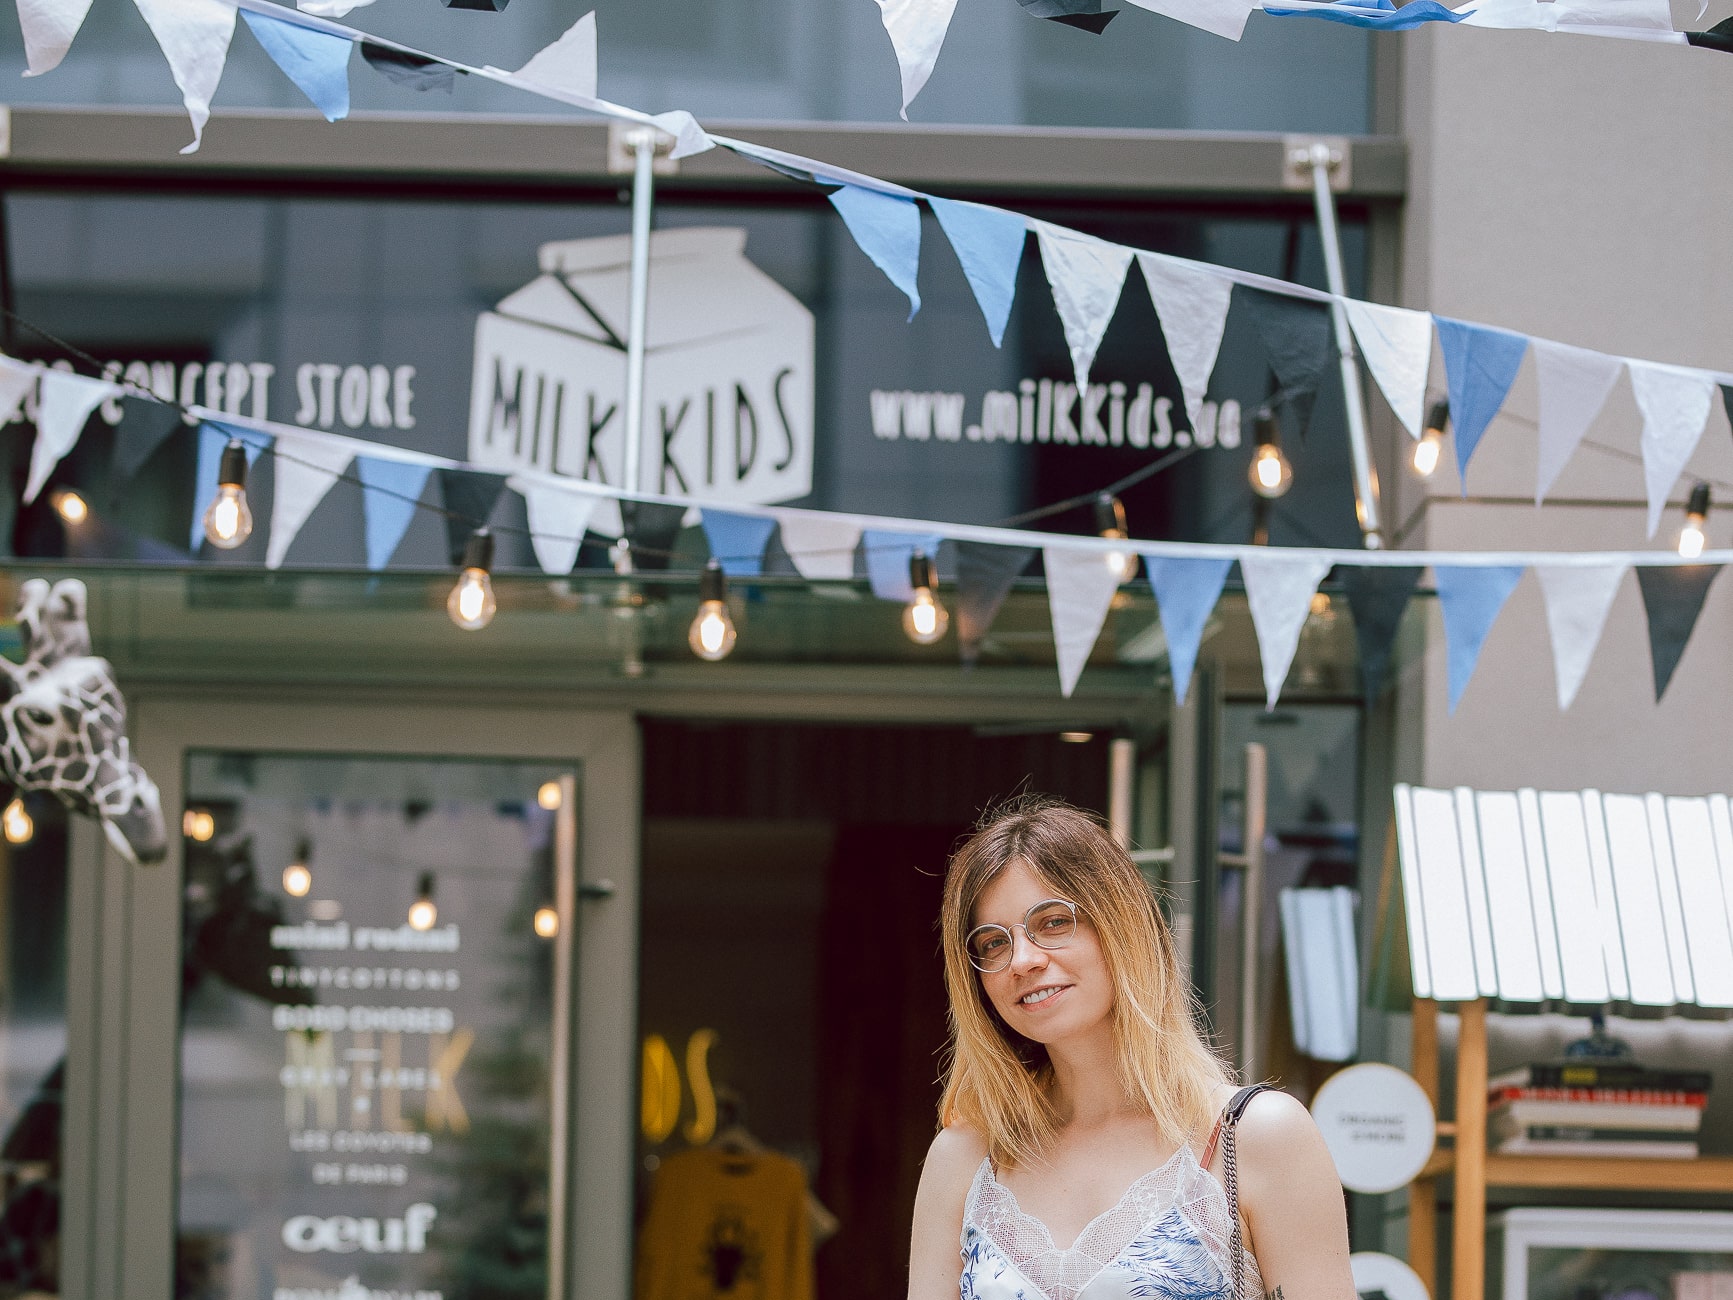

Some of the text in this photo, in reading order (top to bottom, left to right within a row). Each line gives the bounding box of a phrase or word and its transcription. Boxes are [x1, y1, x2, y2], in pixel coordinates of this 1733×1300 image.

[295, 361, 418, 430] STORE
[485, 356, 795, 495] MILK KIDS
